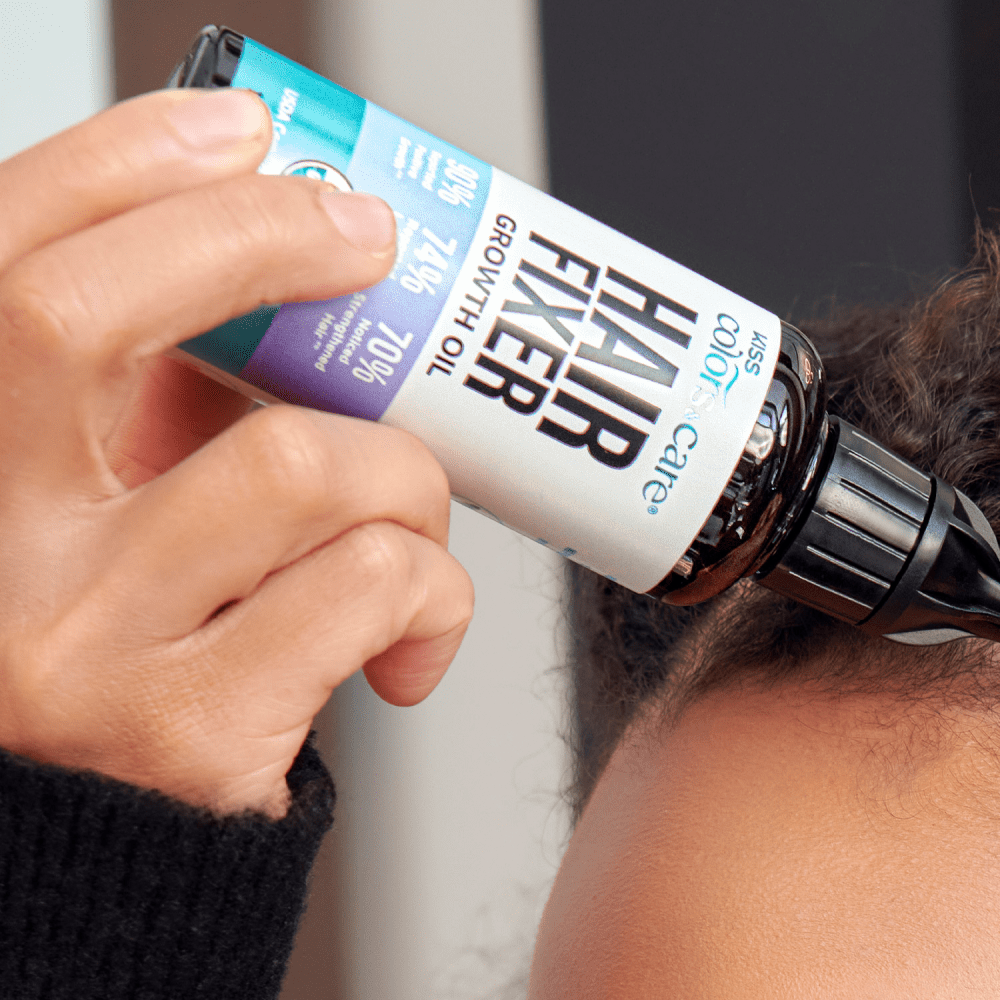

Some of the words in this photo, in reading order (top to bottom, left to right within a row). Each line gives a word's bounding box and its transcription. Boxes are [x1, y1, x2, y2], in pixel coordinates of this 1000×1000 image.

[276, 87, 300, 121] USDA
[437, 158, 479, 208] 90%
[400, 227, 458, 296] 74%
[454, 213, 517, 332] GROWTH
[314, 293, 367, 373] Strengthened
[339, 317, 373, 365] Noticed
[352, 321, 414, 386] 70%
[426, 335, 465, 376] OIL
[463, 230, 600, 416] FIXER
[745, 330, 768, 376] KISS
[536, 266, 698, 470] HAIR
